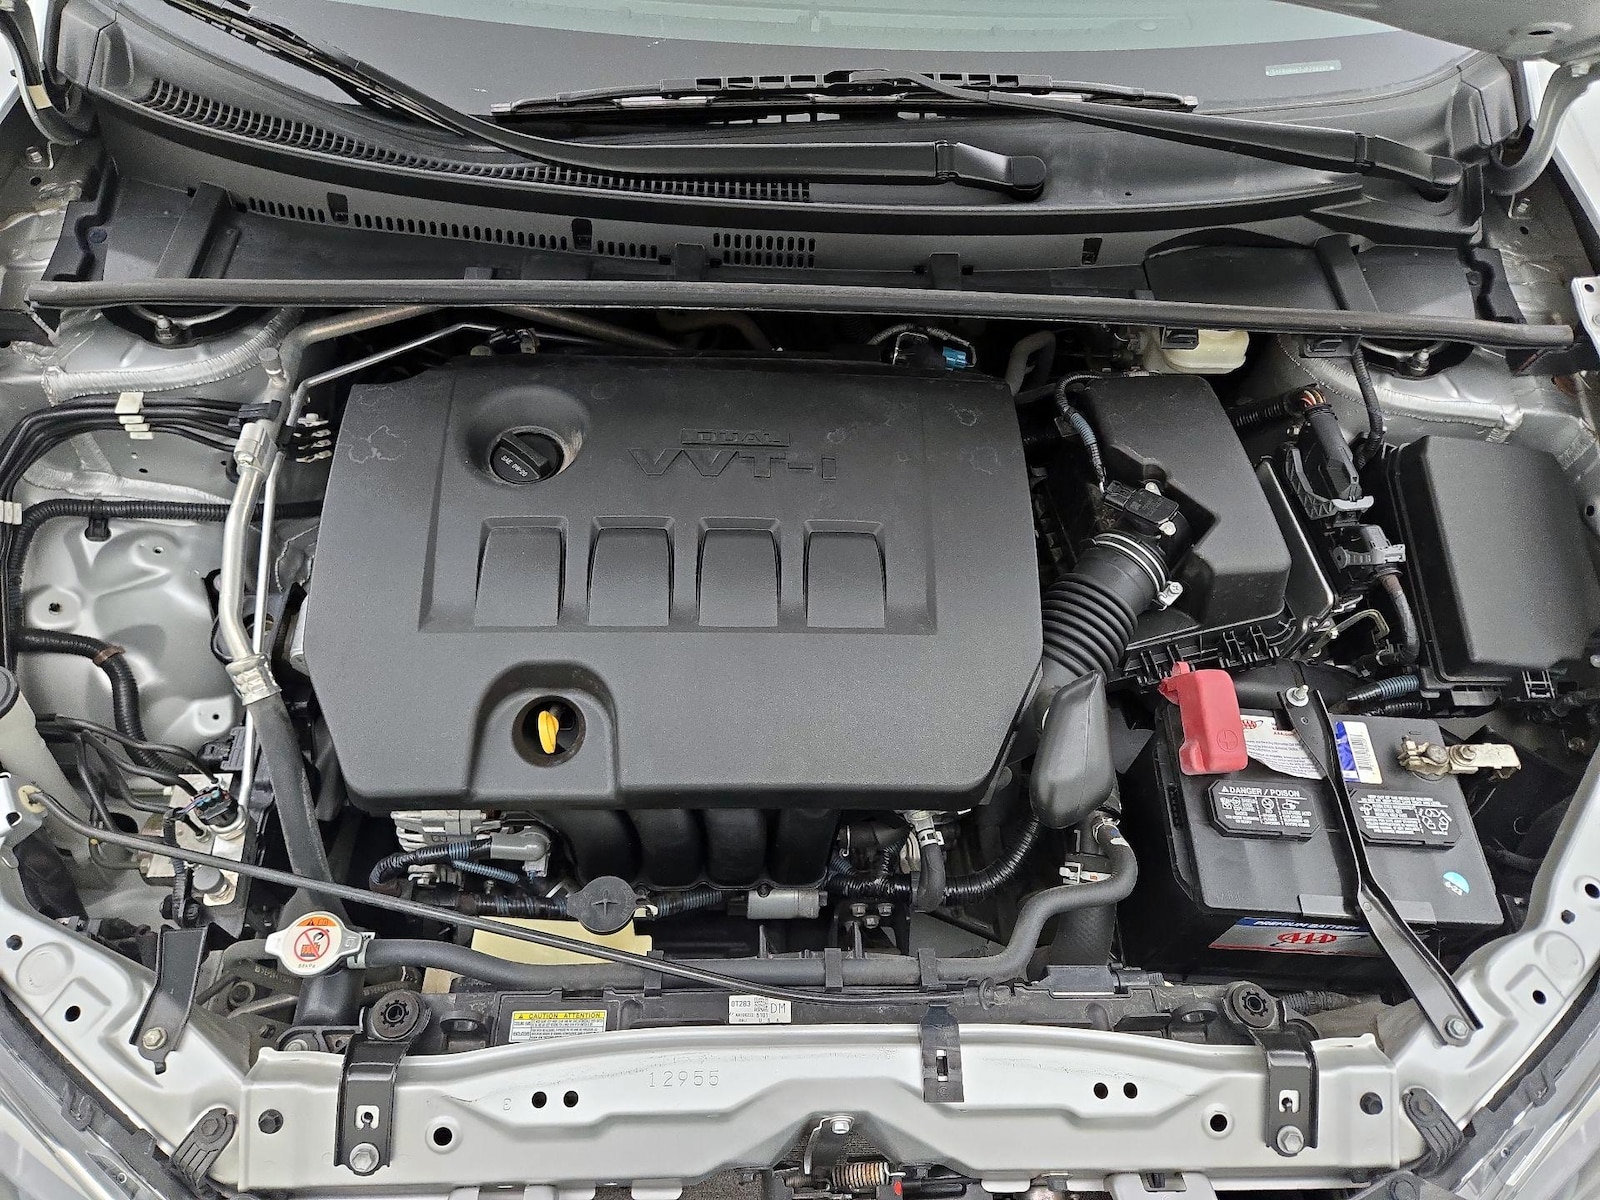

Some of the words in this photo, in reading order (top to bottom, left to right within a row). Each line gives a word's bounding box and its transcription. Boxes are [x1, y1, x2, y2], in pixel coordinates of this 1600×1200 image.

[697, 431, 781, 442] DUAL
[501, 455, 513, 465] SAE
[511, 463, 528, 477] 0W-20
[1229, 786, 1262, 796] DANGER
[1270, 789, 1300, 798] POISON
[1254, 920, 1308, 928] PREMIUM
[1308, 923, 1359, 931] BATTERY
[1278, 932, 1335, 944] AAA
[770, 1002, 786, 1014] DM
[649, 1070, 719, 1087] 12955
